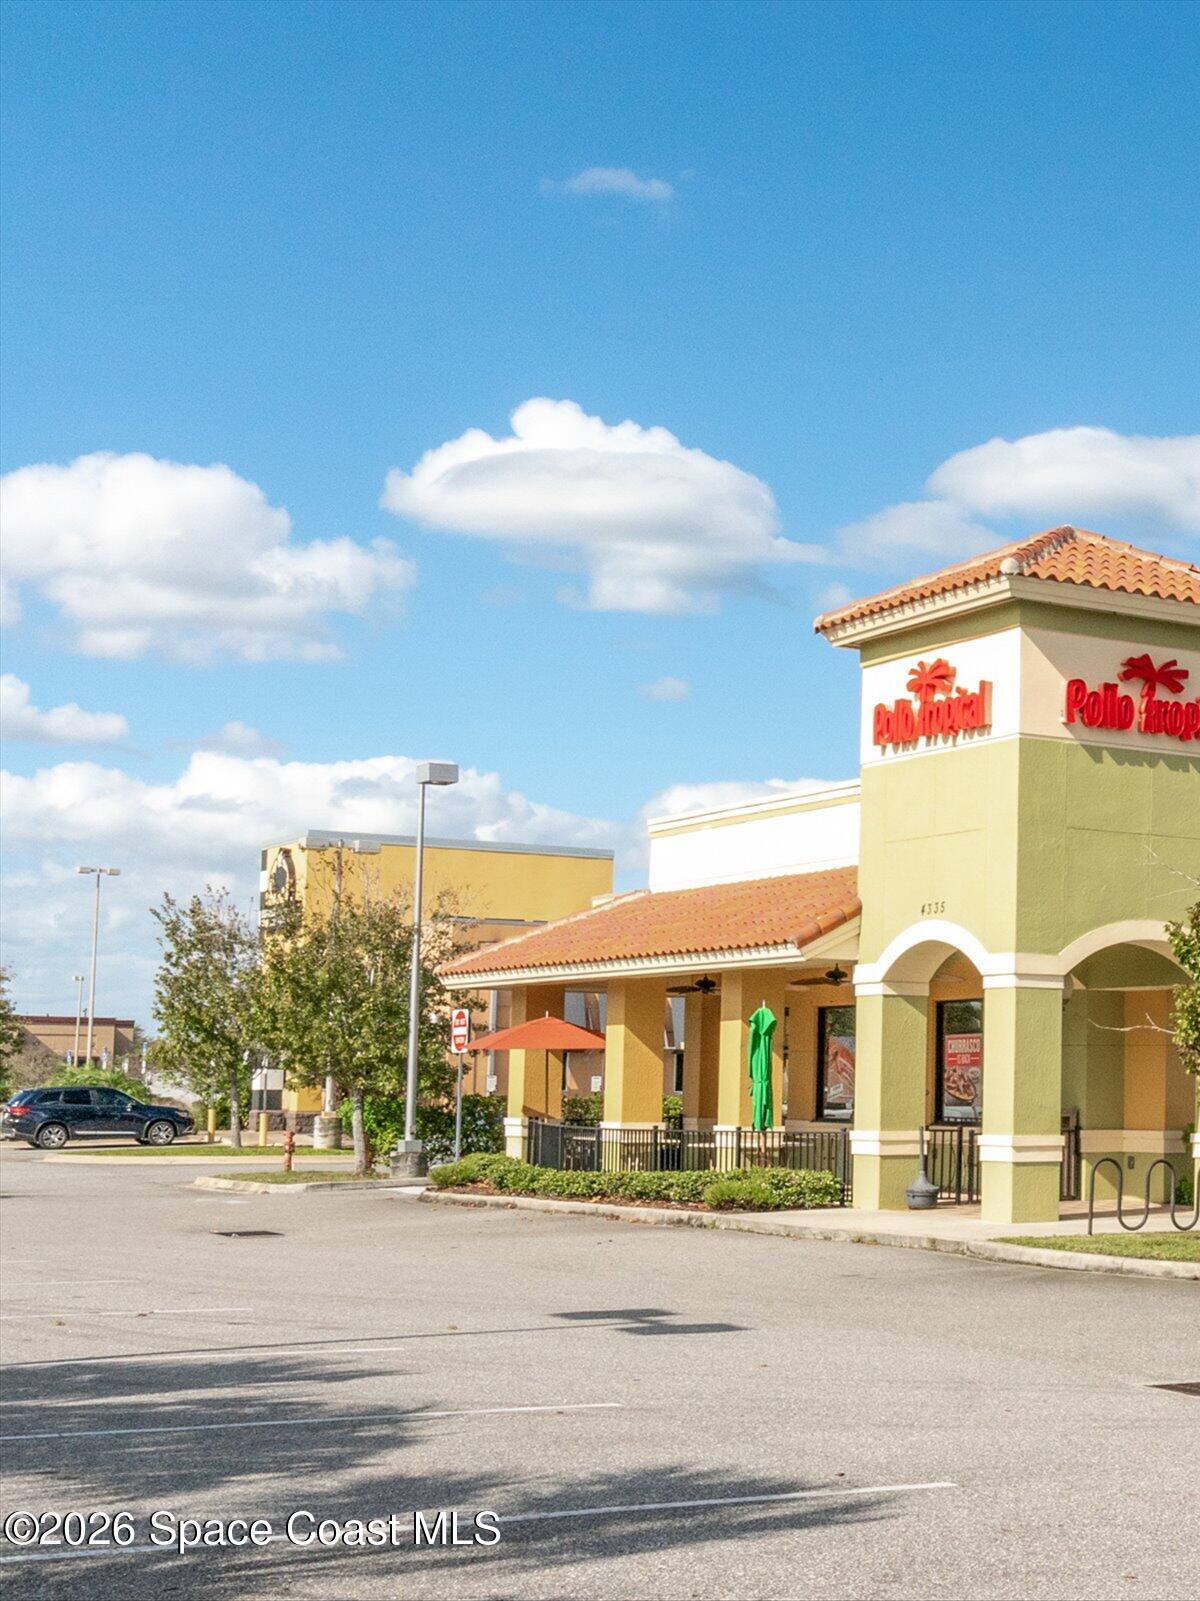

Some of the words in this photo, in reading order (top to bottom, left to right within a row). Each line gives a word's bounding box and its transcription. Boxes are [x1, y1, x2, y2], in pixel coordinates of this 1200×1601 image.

[873, 699, 917, 746] Pollo
[918, 680, 992, 738] Tropical
[1065, 678, 1135, 731] Pollo
[921, 901, 945, 915] 4335
[948, 1039, 981, 1053] CHURRASCO
